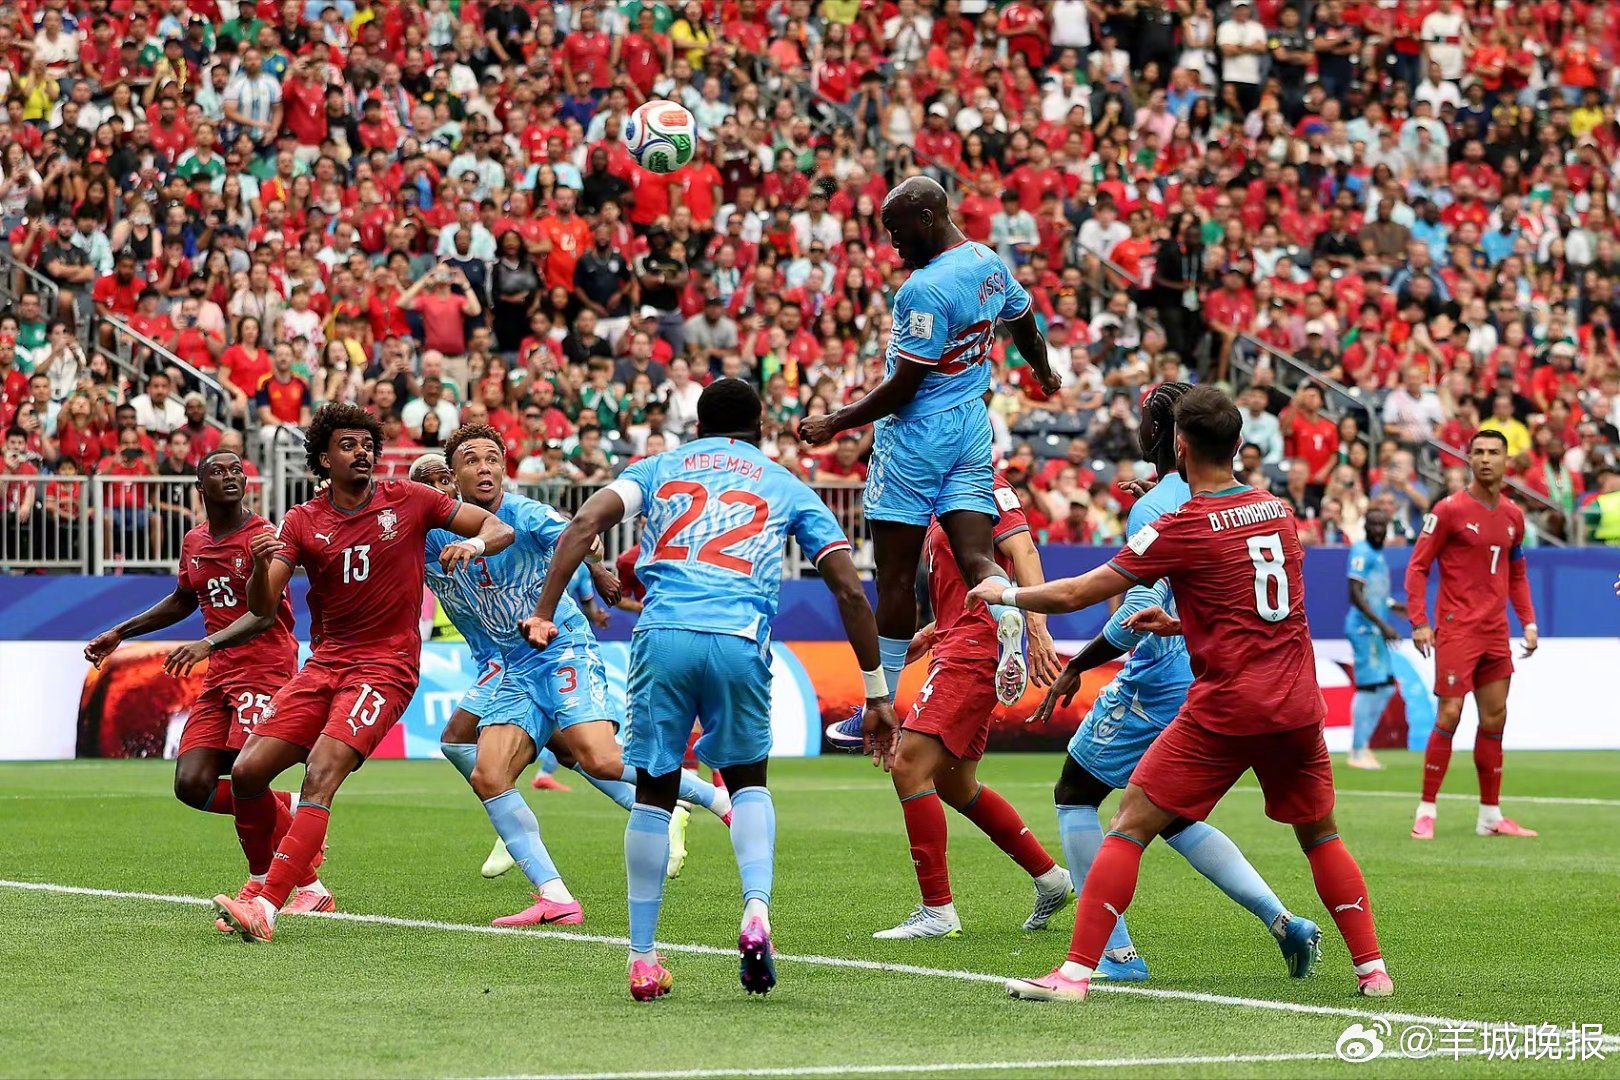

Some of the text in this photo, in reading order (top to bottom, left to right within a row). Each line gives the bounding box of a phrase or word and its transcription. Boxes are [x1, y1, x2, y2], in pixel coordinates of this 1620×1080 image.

[684, 454, 764, 481] MBEMBA
[650, 480, 770, 576] 22
[341, 545, 371, 583] 13
[474, 557, 493, 588] 3
[1489, 545, 1501, 574] 7
[207, 576, 238, 608] 25
[1246, 532, 1291, 622] 8
[478, 661, 502, 686] 7
[556, 666, 577, 693] 3
[920, 666, 941, 703] 4
[237, 691, 271, 725] 25
[349, 683, 387, 726] 13
